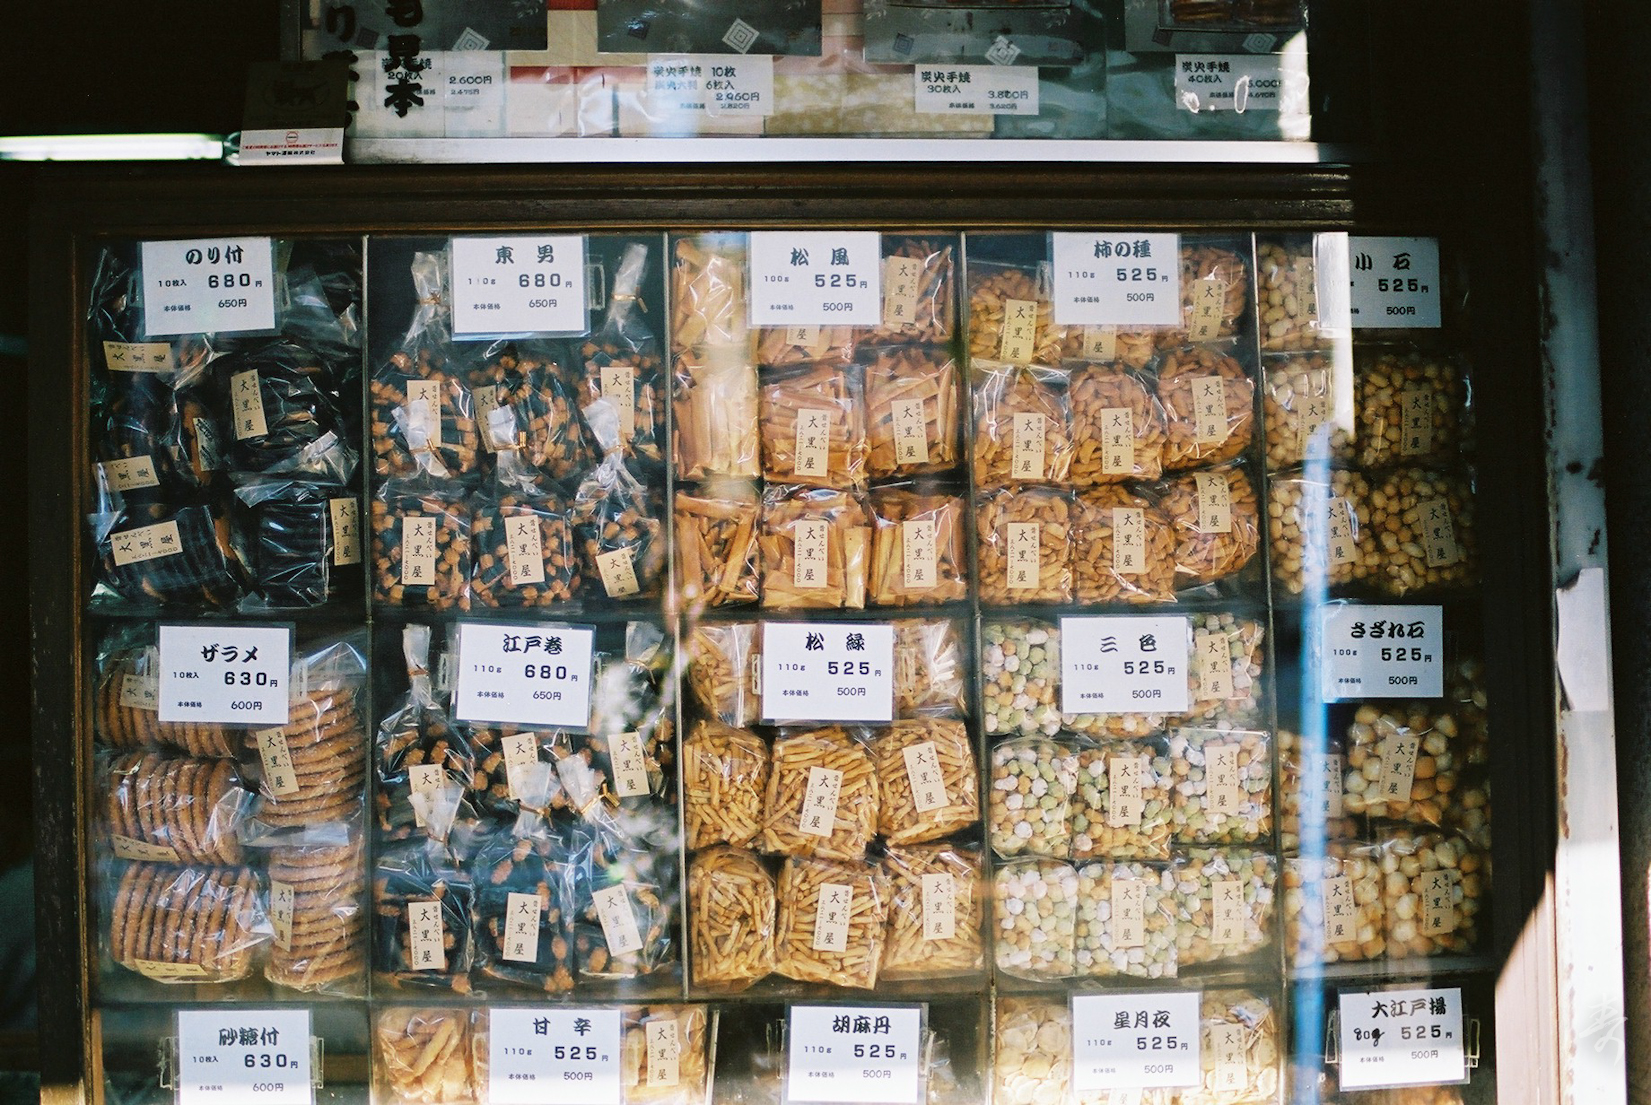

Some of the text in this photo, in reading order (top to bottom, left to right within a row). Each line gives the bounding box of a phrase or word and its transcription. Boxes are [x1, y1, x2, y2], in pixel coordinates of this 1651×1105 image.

[921, 69, 973, 85] 炭火手焼
[1181, 60, 1231, 74] 炭火手焼
[704, 79, 736, 92] 6枚入
[926, 83, 962, 96] 30枚入
[1187, 74, 1223, 85] 40枚入
[185, 244, 244, 265] のり付
[495, 244, 555, 265] 東男
[790, 247, 850, 267] 松風
[1093, 239, 1152, 259] 柿の種
[1355, 251, 1412, 271] 小石
[158, 273, 263, 289] 10枚入 680円
[467, 273, 573, 288] 110g 680円
[764, 273, 868, 289] 100g 525円
[1068, 267, 1169, 283] 110g 525円
[894, 265, 908, 316] 大黒屋
[1378, 278, 1429, 294] 525円
[163, 298, 248, 312] 本体価格 650円
[473, 298, 558, 311] 本体価格 650円
[822, 302, 854, 312] 500円
[1073, 292, 1155, 304] 本体価格 500円
[1198, 286, 1214, 336] 大黒屋
[1386, 305, 1416, 316] 500円
[1010, 307, 1026, 358] 大黒屋
[112, 352, 167, 363] 大黒屋
[239, 379, 255, 431] 大黒屋
[1203, 384, 1217, 436] 大黒屋
[903, 406, 916, 458] 大黒屋
[1410, 398, 1422, 448] 大黒屋
[805, 416, 818, 469] 大黒屋
[1020, 420, 1034, 471] 大黒屋
[1112, 415, 1124, 466] 大黒屋
[1207, 476, 1220, 527] 大黒屋
[339, 505, 352, 557] 大黒屋
[1122, 513, 1134, 566] 大黒屋
[1327, 507, 1345, 558] 大黒屋
[1429, 508, 1447, 560] 大黒屋
[119, 534, 175, 552] 大黒屋
[411, 525, 425, 578] 大黒屋
[517, 523, 532, 576] 大黒屋
[803, 527, 816, 580] 大黒屋
[913, 528, 925, 580] 大黒屋
[1016, 530, 1029, 582] 大黒屋
[609, 559, 626, 594] 大黒屋
[1350, 619, 1426, 640] さざれ石
[502, 633, 563, 656] 江戸巻
[805, 631, 865, 652] 松緑
[1099, 633, 1157, 653] 三色
[200, 643, 259, 664] ザラメ
[1333, 647, 1433, 663] 100g 525円
[474, 664, 578, 682] 110g 680円
[778, 661, 882, 677] 110g 525円
[1074, 660, 1176, 675] 110g 525円
[1207, 641, 1221, 692] 大黒屋
[173, 671, 278, 688] 10枚入 630円
[1388, 675, 1418, 685] 500円
[476, 690, 562, 701] 本体価格 650円
[782, 686, 866, 697] 本体価格 500円
[1080, 689, 1162, 700] 本体価格 500円
[177, 700, 263, 711] 本体価格 600円
[267, 736, 286, 787] 大黒屋
[620, 740, 637, 790] 大黒屋
[1387, 743, 1405, 794] 大黒屋
[915, 753, 936, 804] 大黒屋
[1215, 754, 1228, 807] 大黒屋
[809, 775, 829, 828] 大黒屋
[1118, 765, 1132, 817] 大黒屋
[932, 881, 944, 934] 大黒屋
[1332, 885, 1345, 936] 大黒屋
[1431, 878, 1443, 927] 大黒屋
[607, 896, 627, 947] 大黒屋
[823, 891, 841, 944] 大黒屋
[1121, 888, 1133, 939] 大黒屋
[1222, 889, 1235, 938] 大黒屋
[419, 909, 433, 962] 大黒屋
[513, 902, 529, 956] 大黒屋
[1371, 995, 1447, 1019] 大江戸揚
[532, 1016, 592, 1037] 甘辛
[832, 1014, 892, 1035] 胡麻丹
[1113, 1010, 1171, 1030] 星月夜
[218, 1026, 280, 1047] 砂糖付
[1087, 1036, 1188, 1051] 110g 525円
[1353, 1024, 1453, 1048] 80g 525円
[192, 1053, 299, 1069] 10枚入 630円
[504, 1046, 609, 1062] 110g 525円
[657, 1027, 669, 1080] 大黒屋
[804, 1044, 907, 1060] 110g 525円
[1224, 1033, 1236, 1084] 大黒屋
[1359, 1049, 1439, 1064] 本体価格 500円
[508, 1071, 593, 1081] 本体価格 500円
[862, 1069, 892, 1079] 500円
[1144, 1063, 1174, 1074] 500円
[198, 1081, 285, 1092] 本体価格 600円
